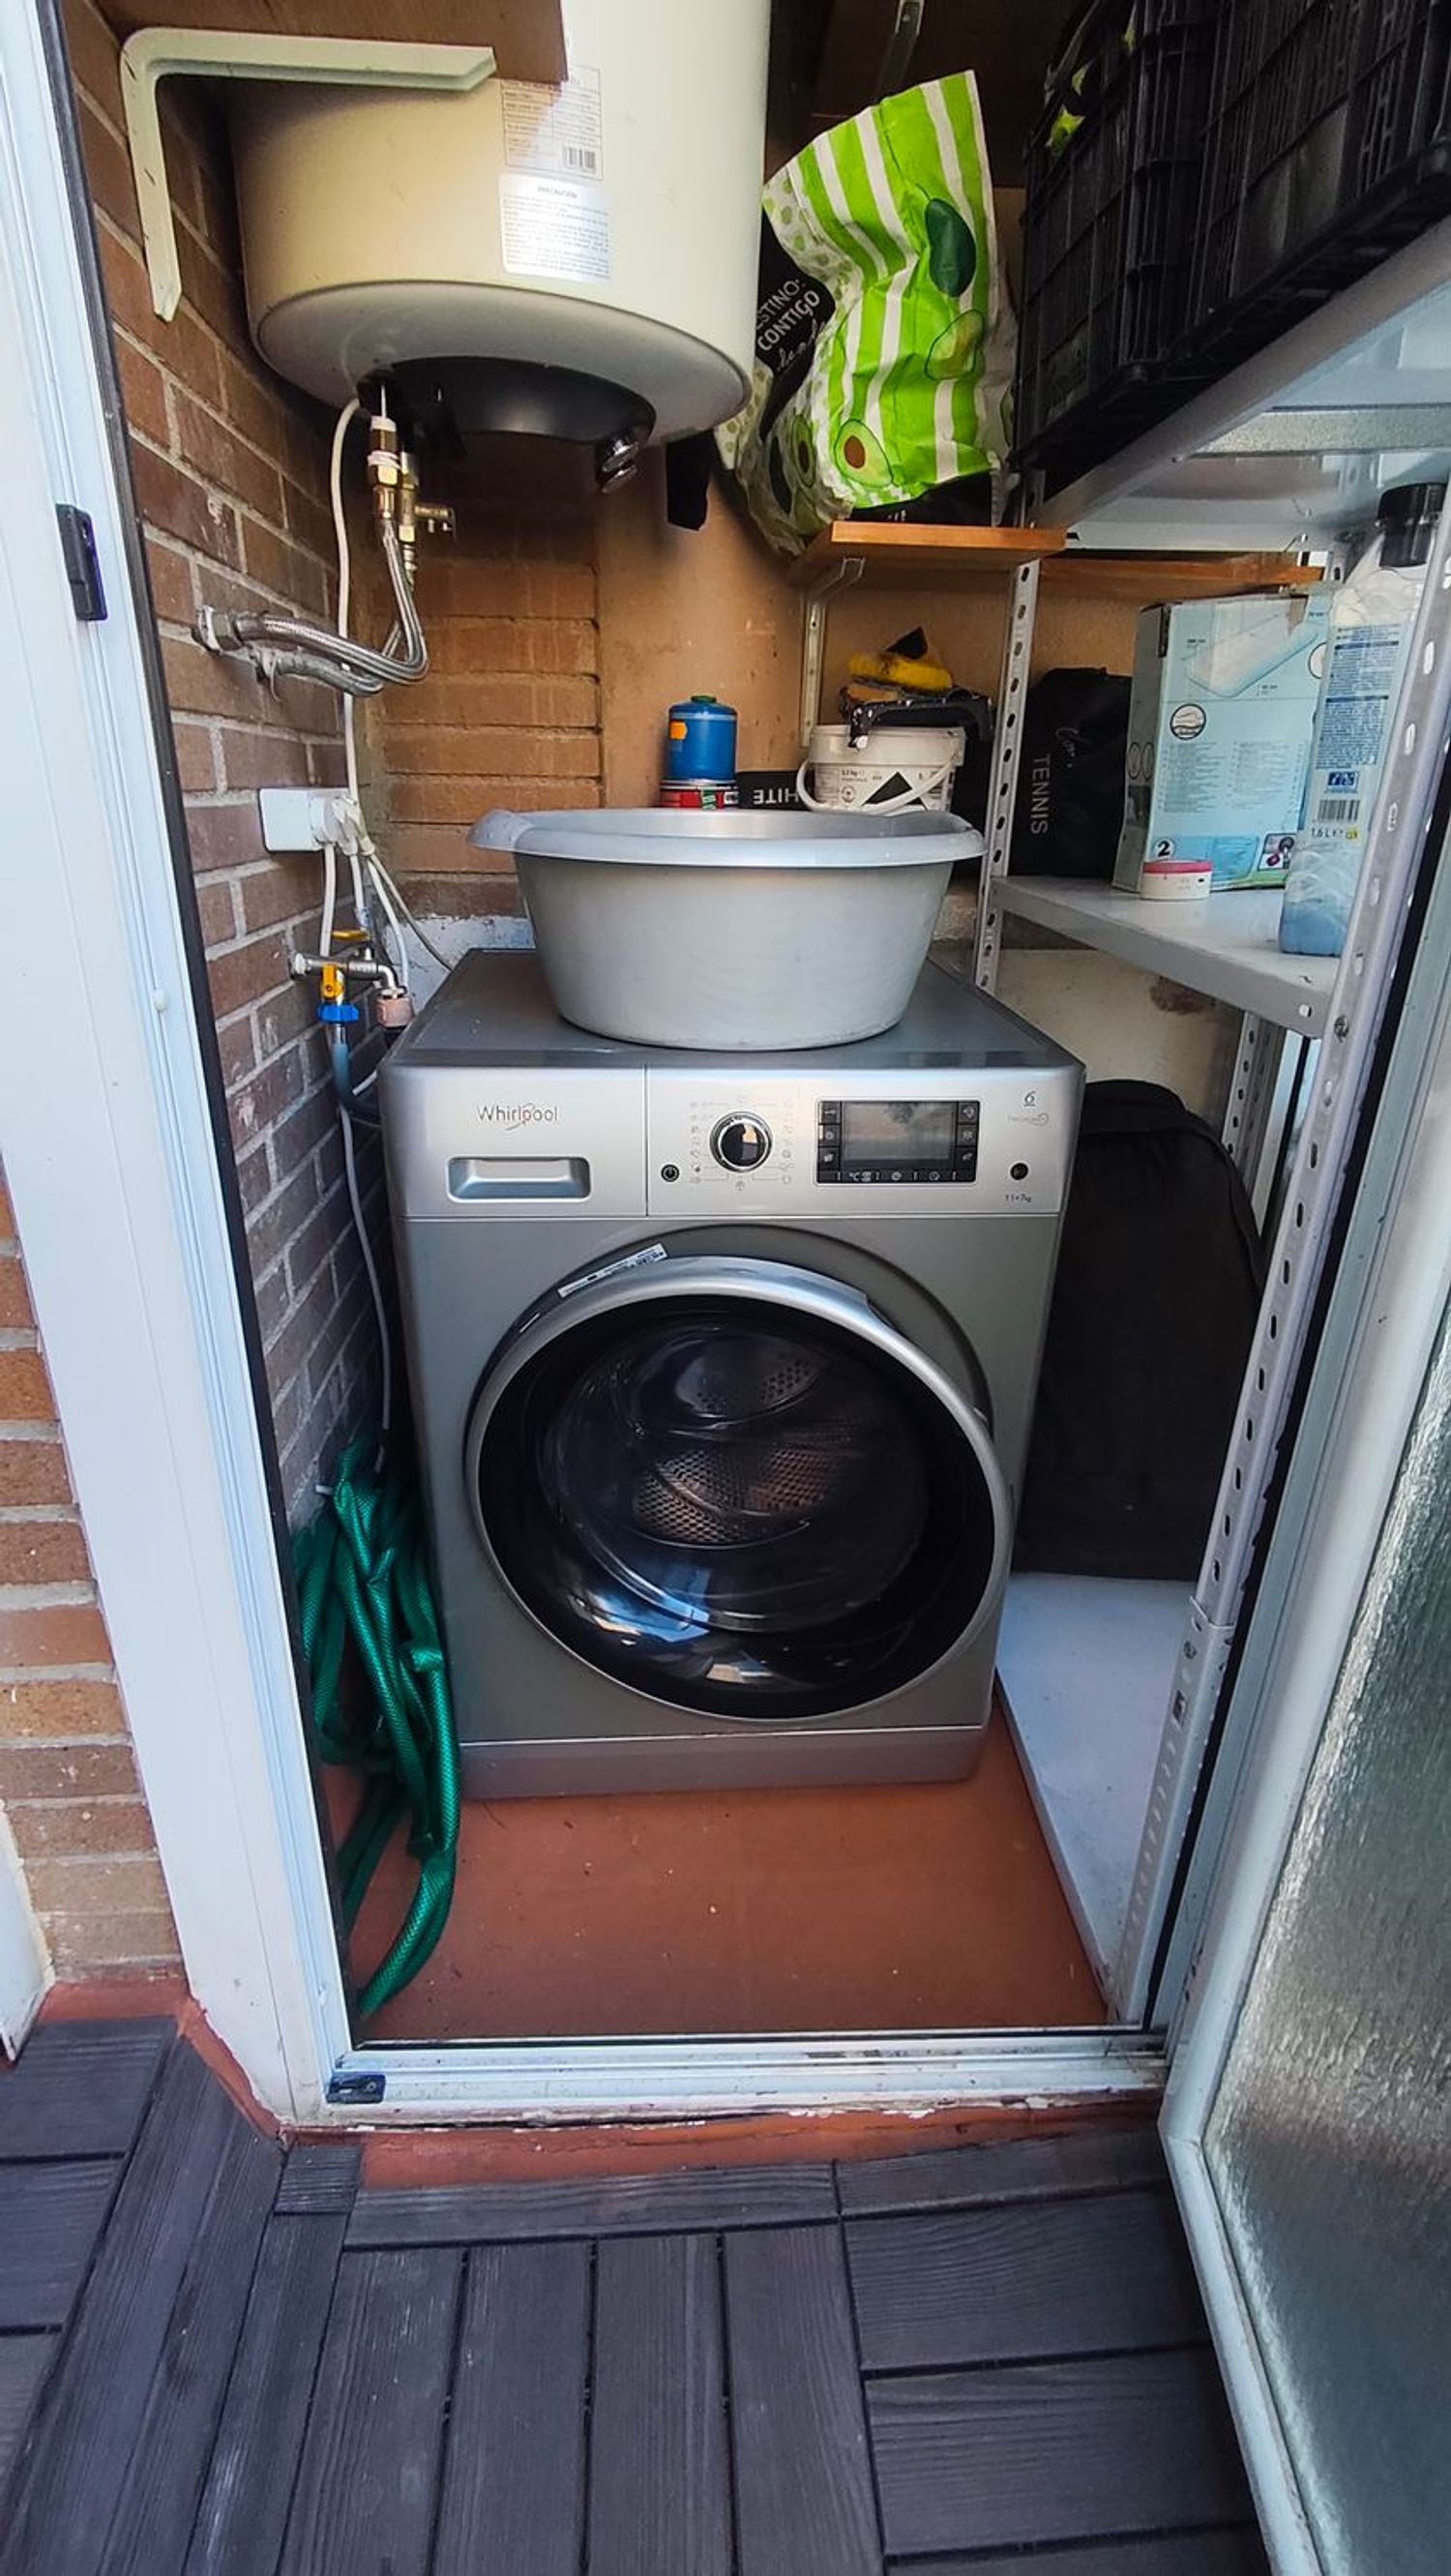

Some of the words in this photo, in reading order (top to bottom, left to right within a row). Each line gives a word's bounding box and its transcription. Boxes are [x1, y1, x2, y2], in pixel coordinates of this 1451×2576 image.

[756, 289, 820, 351] CONTIGO
[1030, 754, 1051, 834] TENNIS
[1158, 841, 1170, 857] 2
[476, 1103, 558, 1128] Whirlpool
